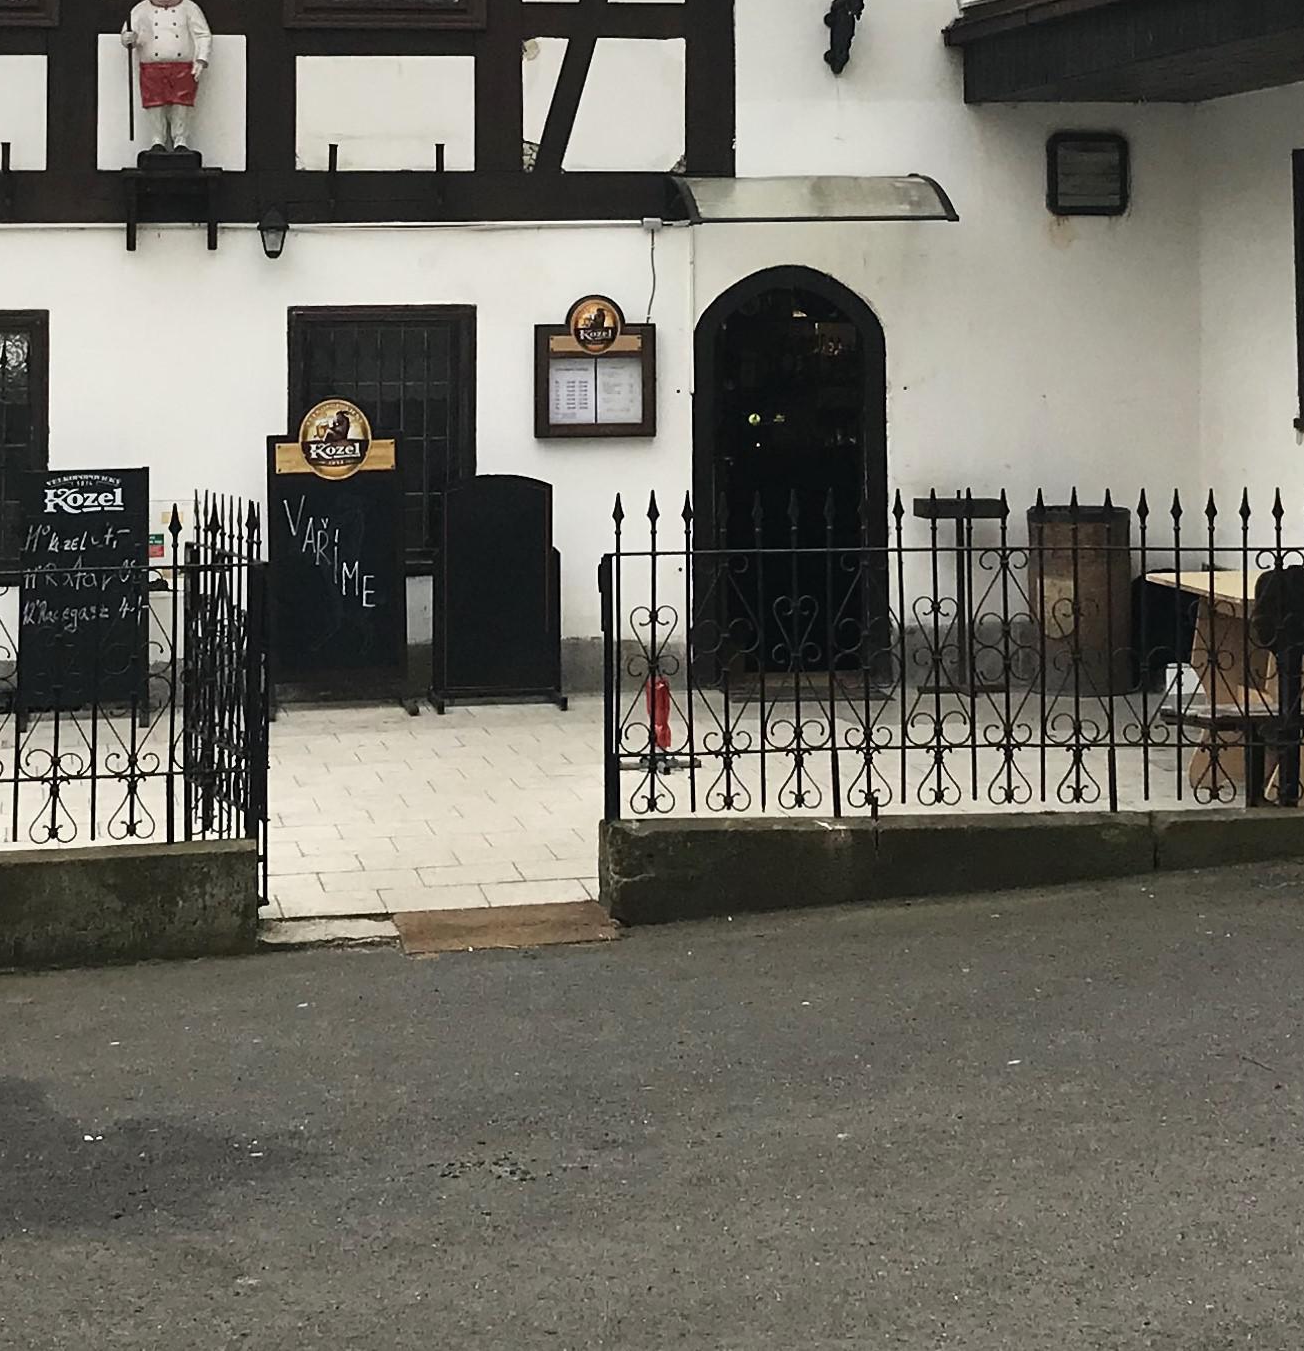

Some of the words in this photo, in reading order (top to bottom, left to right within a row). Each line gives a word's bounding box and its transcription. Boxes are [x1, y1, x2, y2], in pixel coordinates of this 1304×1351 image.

[579, 328, 612, 341] Kozel
[309, 442, 361, 460] Kozel
[43, 487, 125, 514] Kozel
